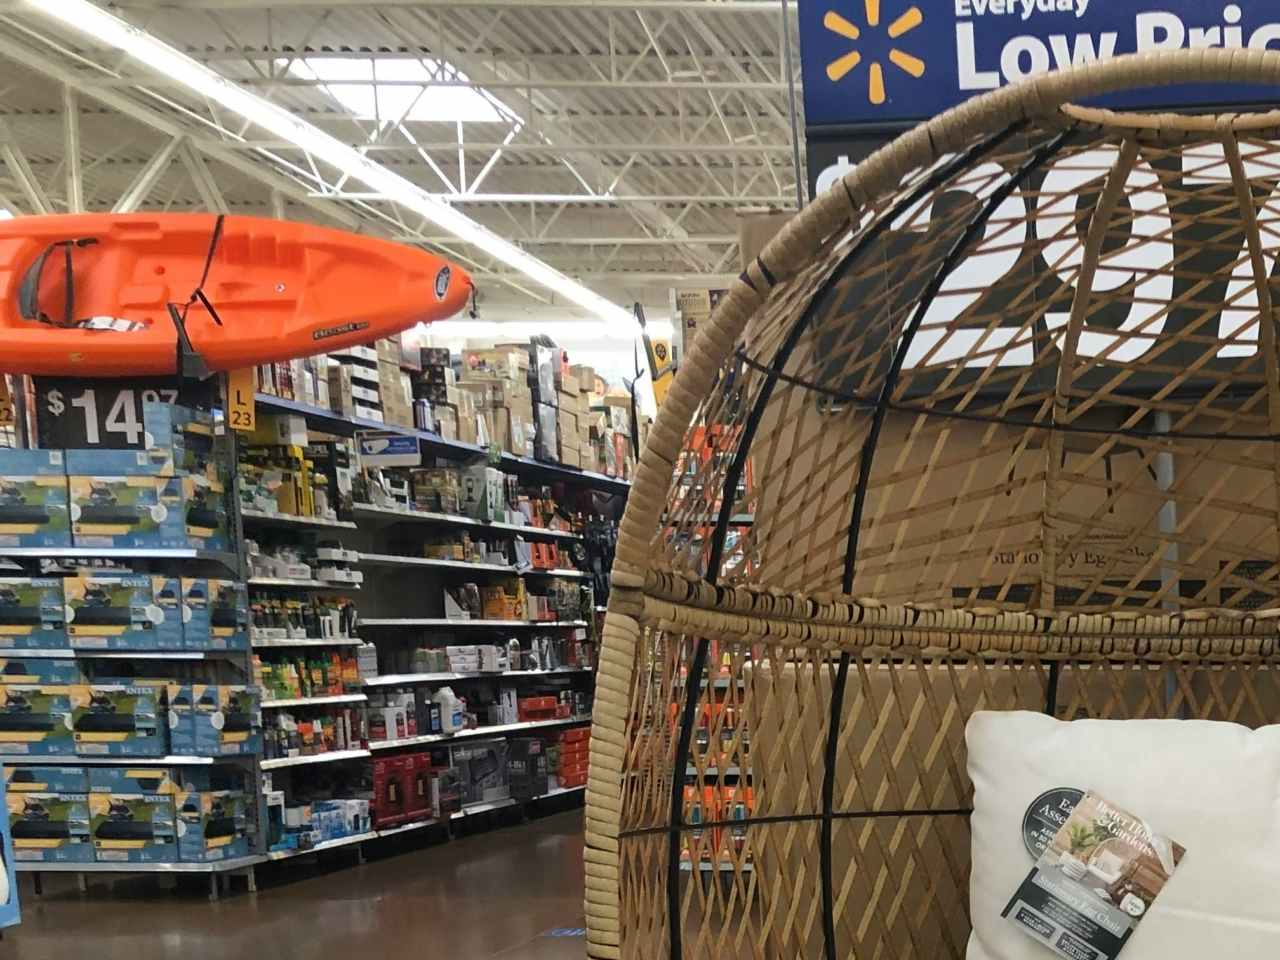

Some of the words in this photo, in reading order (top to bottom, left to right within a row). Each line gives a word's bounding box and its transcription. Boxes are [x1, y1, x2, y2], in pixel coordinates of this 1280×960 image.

[955, 0, 1089, 20] Everyday
[955, 22, 1118, 90] Low
[236, 390, 247, 406] L
[232, 411, 252, 426] 23
[1039, 803, 1067, 826] Asse
[1059, 797, 1075, 814] Ea
